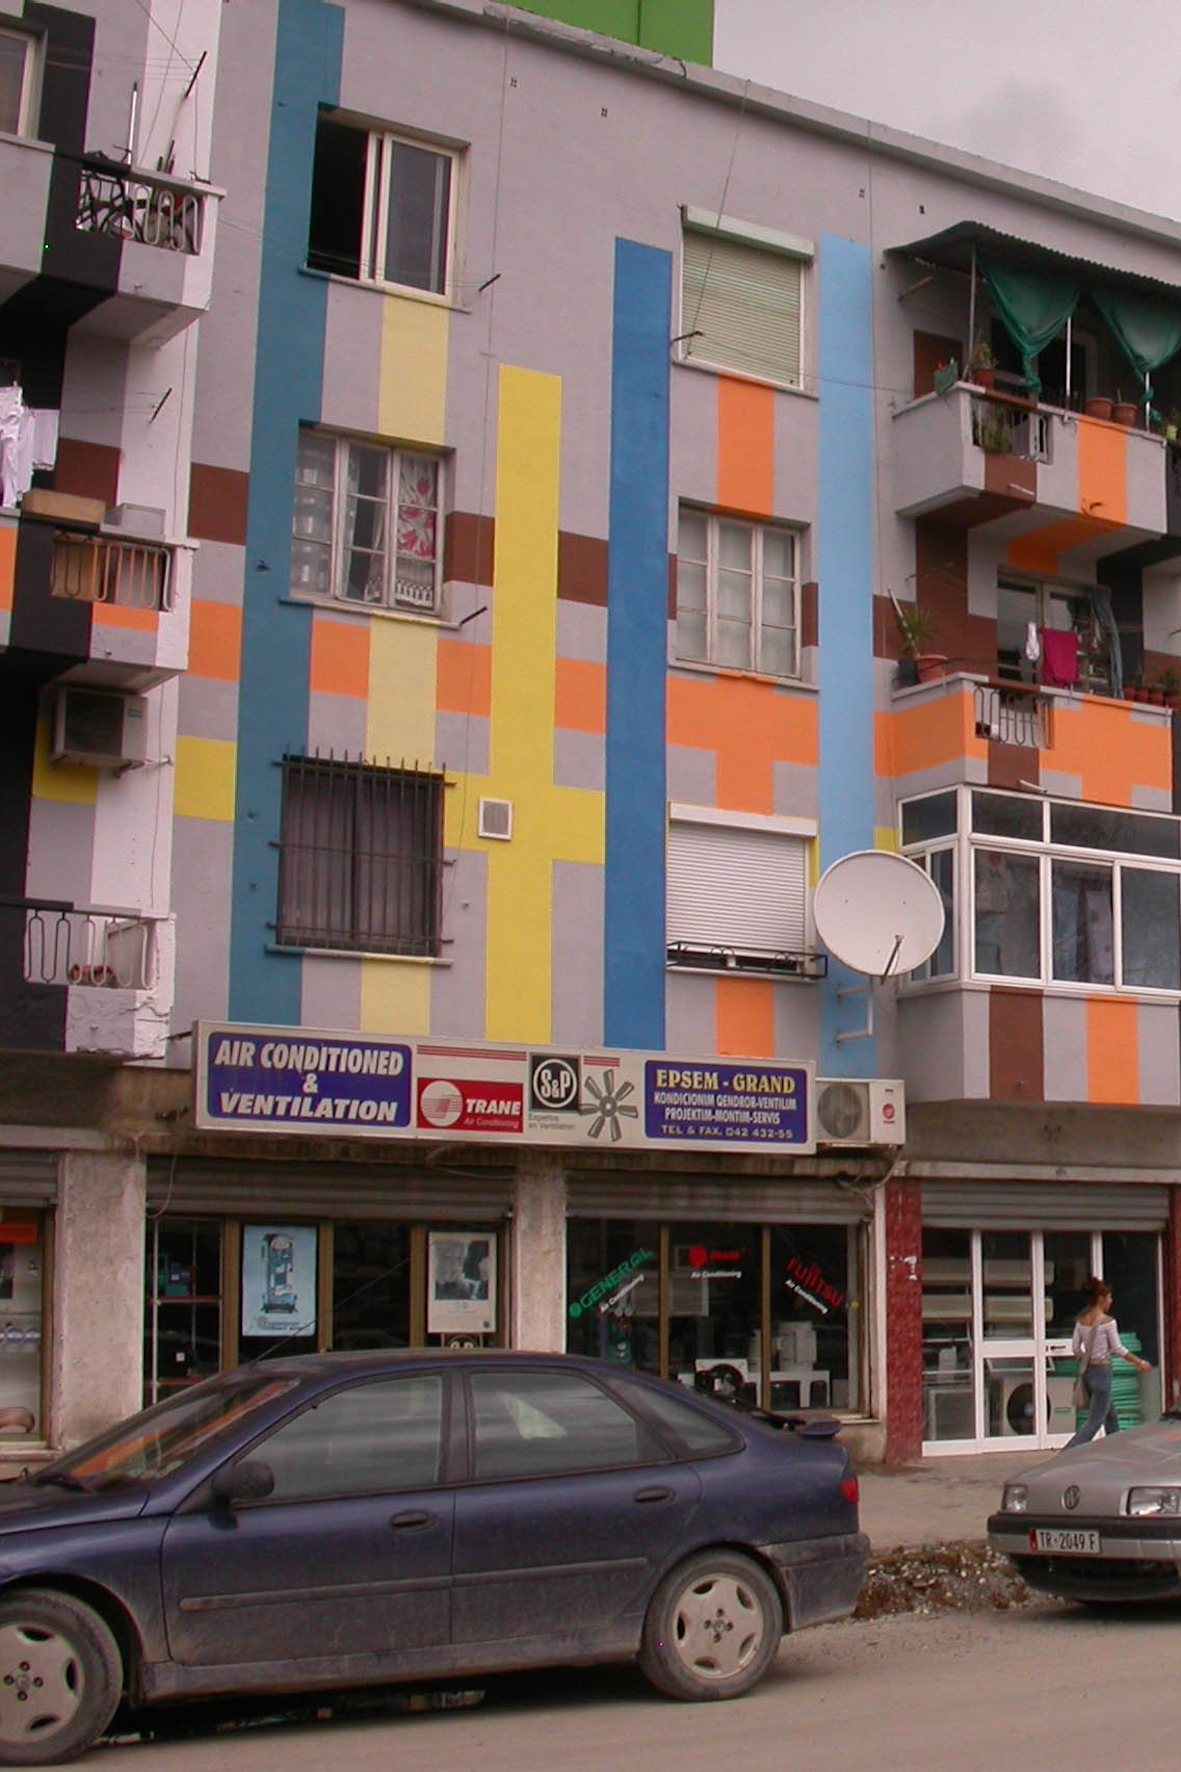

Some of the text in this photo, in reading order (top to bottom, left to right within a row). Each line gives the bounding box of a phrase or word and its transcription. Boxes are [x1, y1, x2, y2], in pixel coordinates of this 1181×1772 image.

[214, 1039, 405, 1077] AIR CONDITIONED
[302, 1072, 319, 1093] &
[540, 1068, 571, 1099] S&P
[655, 1068, 719, 1091] EPSEM
[732, 1073, 796, 1094] GRAND
[220, 1091, 399, 1122] VENTILATION
[465, 1098, 521, 1116] TRANE
[653, 1091, 715, 1108] KONDICIONIM
[580, 1248, 654, 1308] GENERAL
